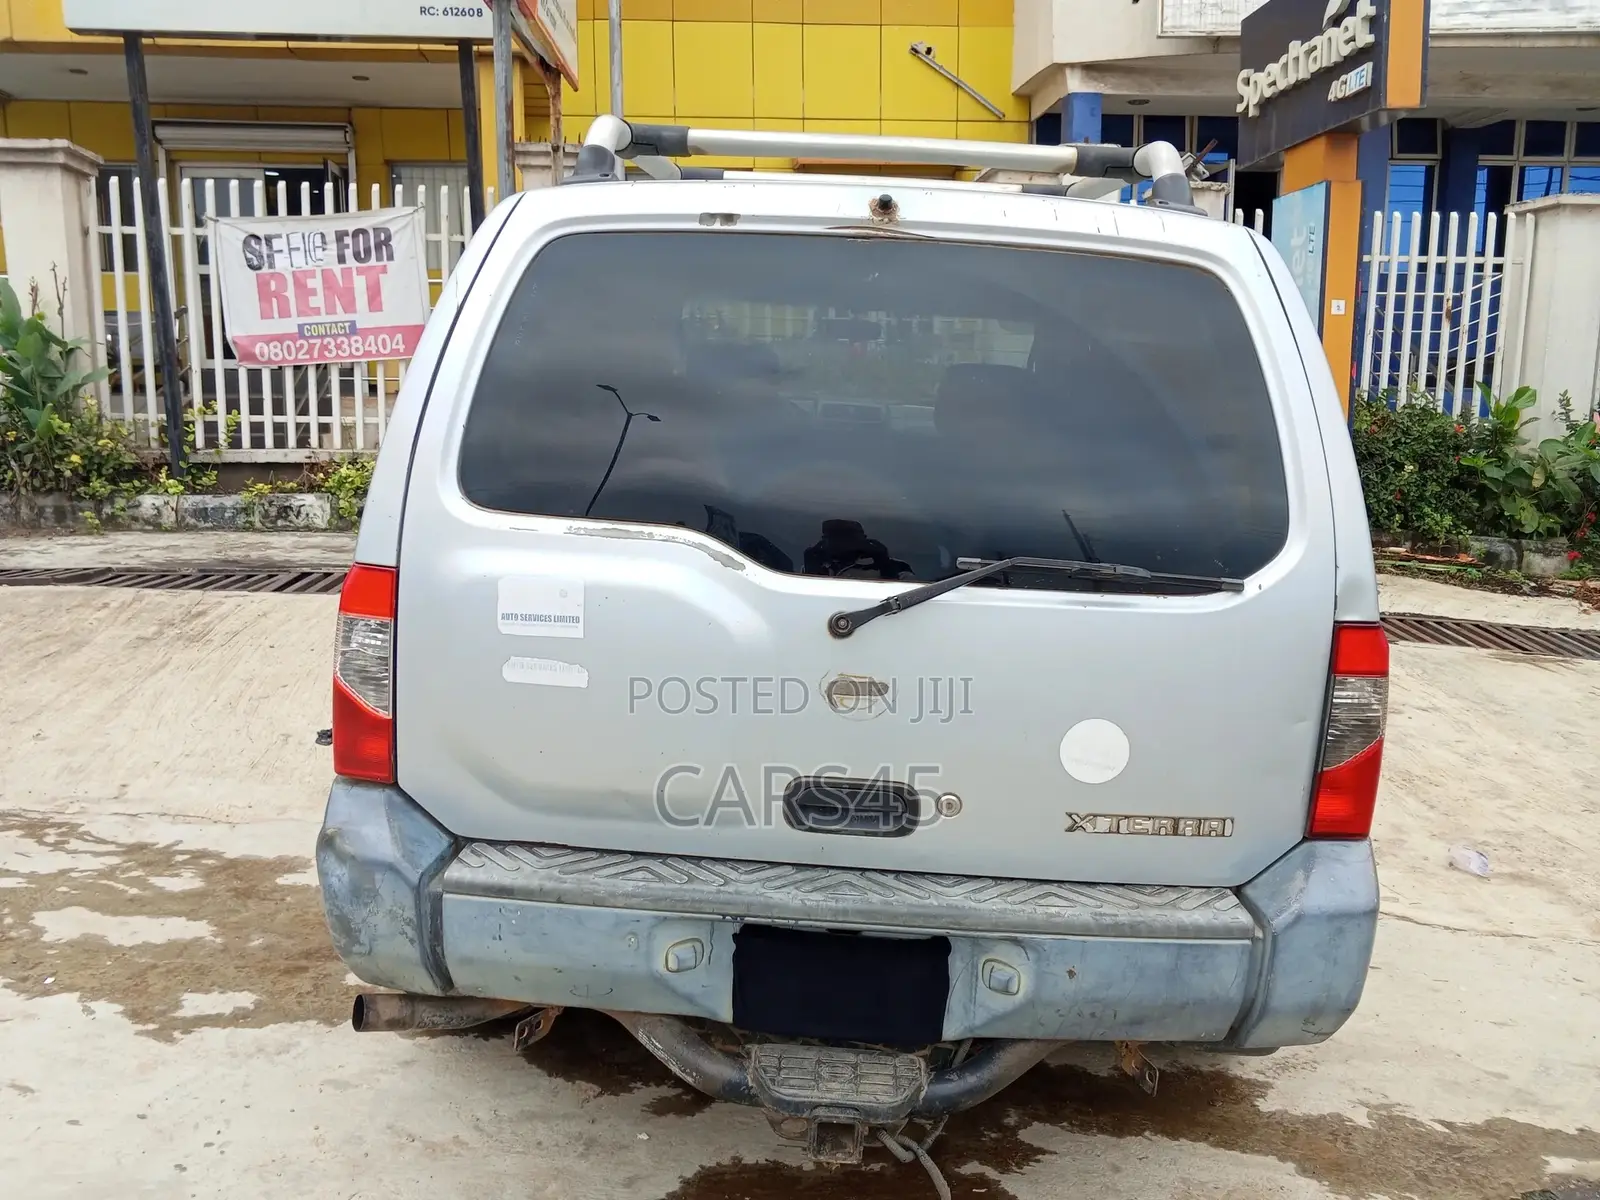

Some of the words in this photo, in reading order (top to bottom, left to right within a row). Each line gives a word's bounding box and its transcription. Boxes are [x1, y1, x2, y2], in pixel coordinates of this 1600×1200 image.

[420, 6, 439, 16] RC:
[442, 8, 483, 17] 612608
[1236, 0, 1376, 117] Spectranet
[335, 227, 394, 264] FOR
[256, 264, 388, 320] RENT
[303, 322, 351, 336] CONTACT
[255, 333, 405, 362] 08027338404
[501, 613, 519, 621] AUTO
[520, 614, 552, 623] SERVICES
[553, 615, 580, 624] LIMITED
[1065, 812, 1234, 837] XTERRA
